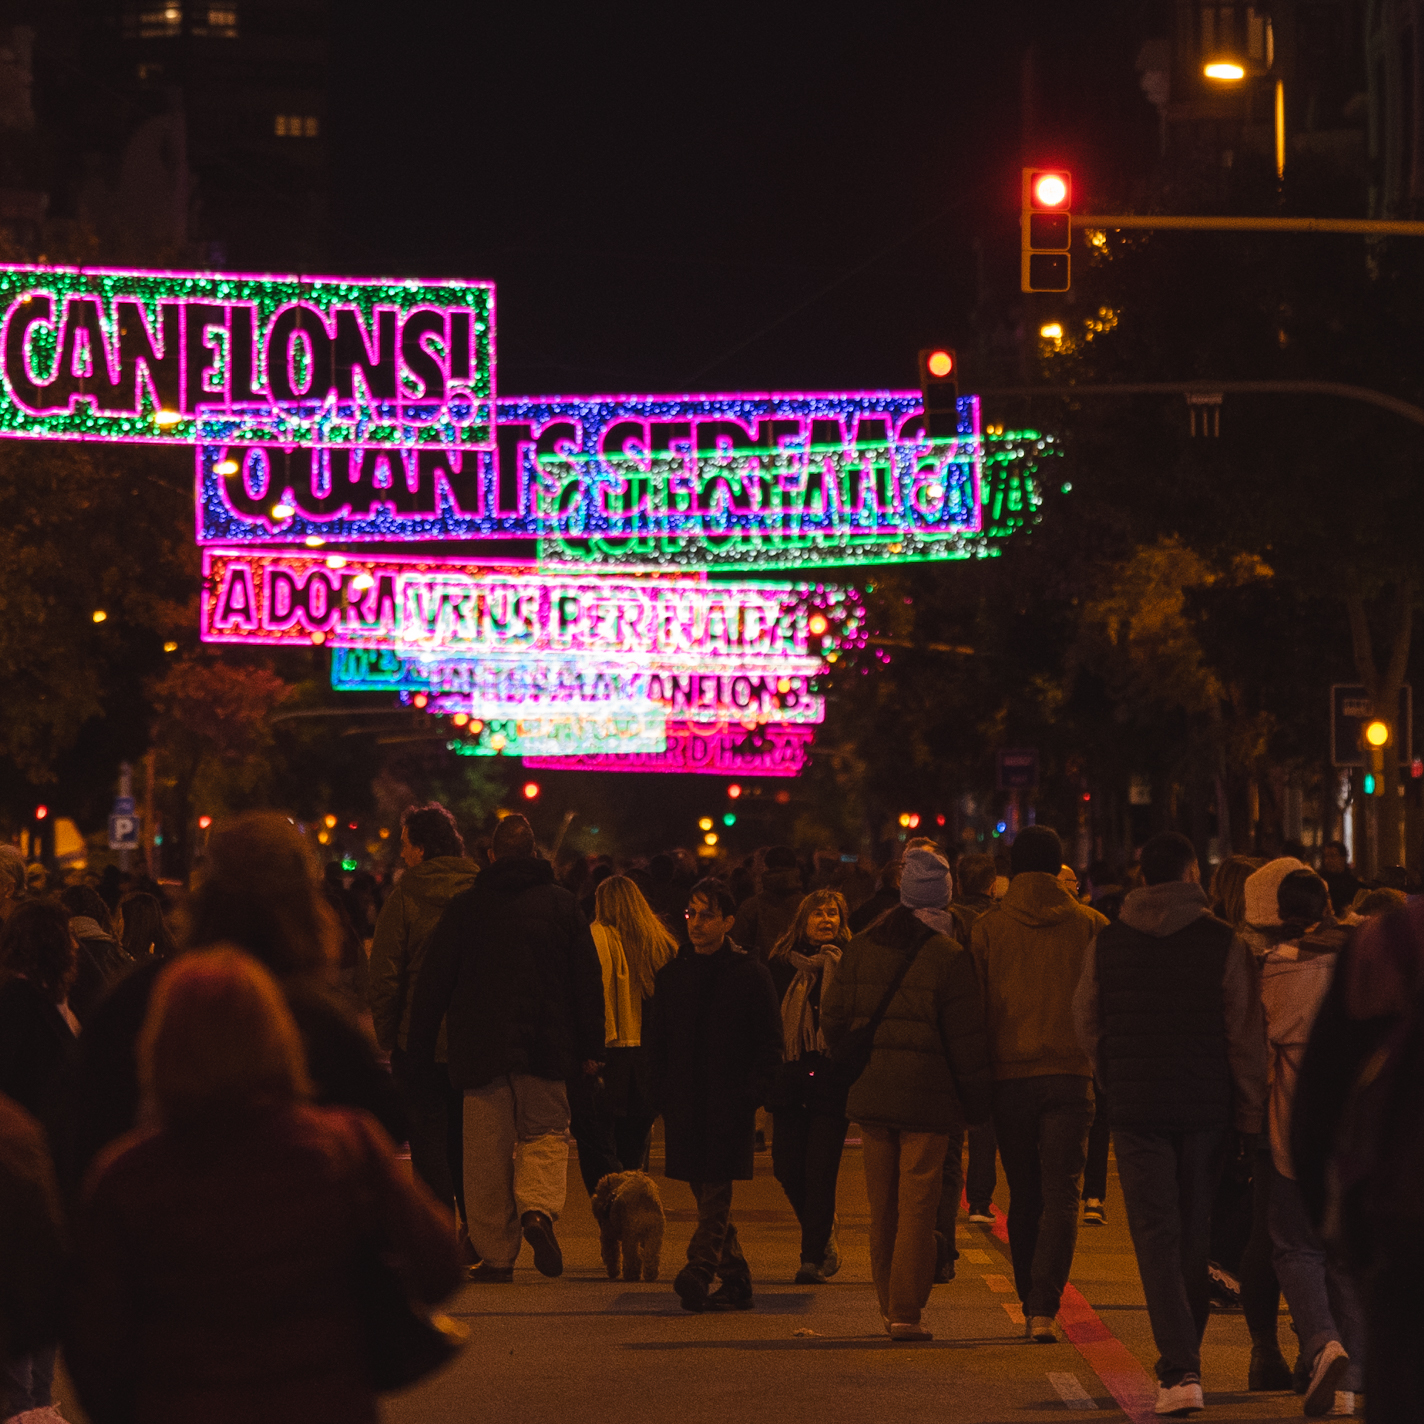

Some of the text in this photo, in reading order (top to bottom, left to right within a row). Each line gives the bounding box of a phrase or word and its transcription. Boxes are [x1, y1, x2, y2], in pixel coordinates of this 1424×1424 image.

[0, 290, 479, 427] CANELONS!
[214, 562, 258, 629] A
[116, 818, 133, 841] P
